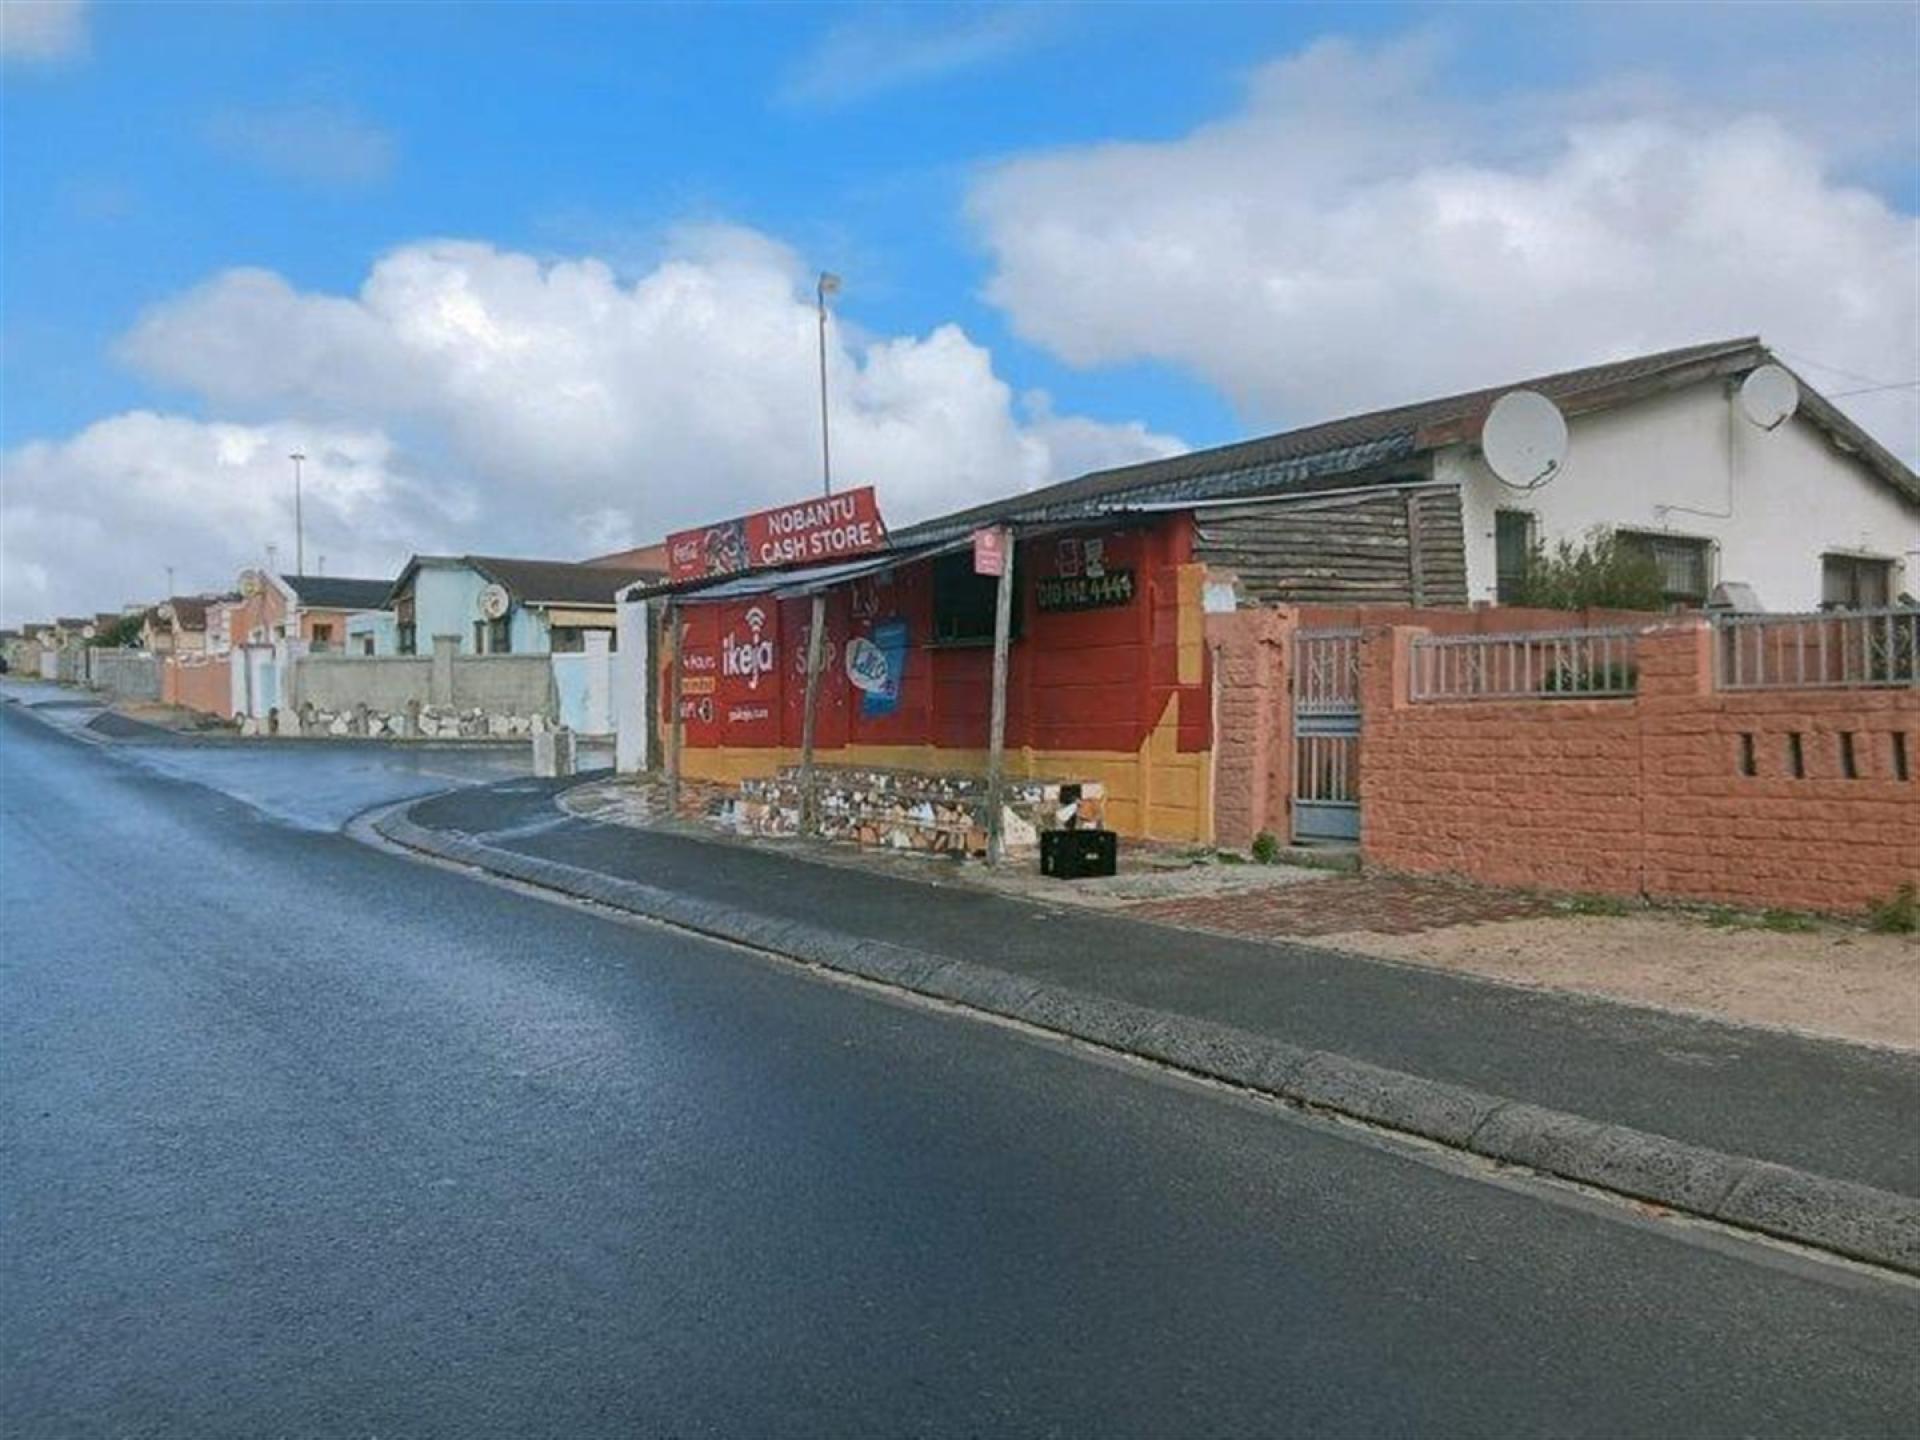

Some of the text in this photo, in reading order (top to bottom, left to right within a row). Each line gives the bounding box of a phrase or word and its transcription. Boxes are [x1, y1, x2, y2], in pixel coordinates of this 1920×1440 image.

[768, 495, 856, 536] NOBANTU
[760, 522, 873, 565] CASH STORE
